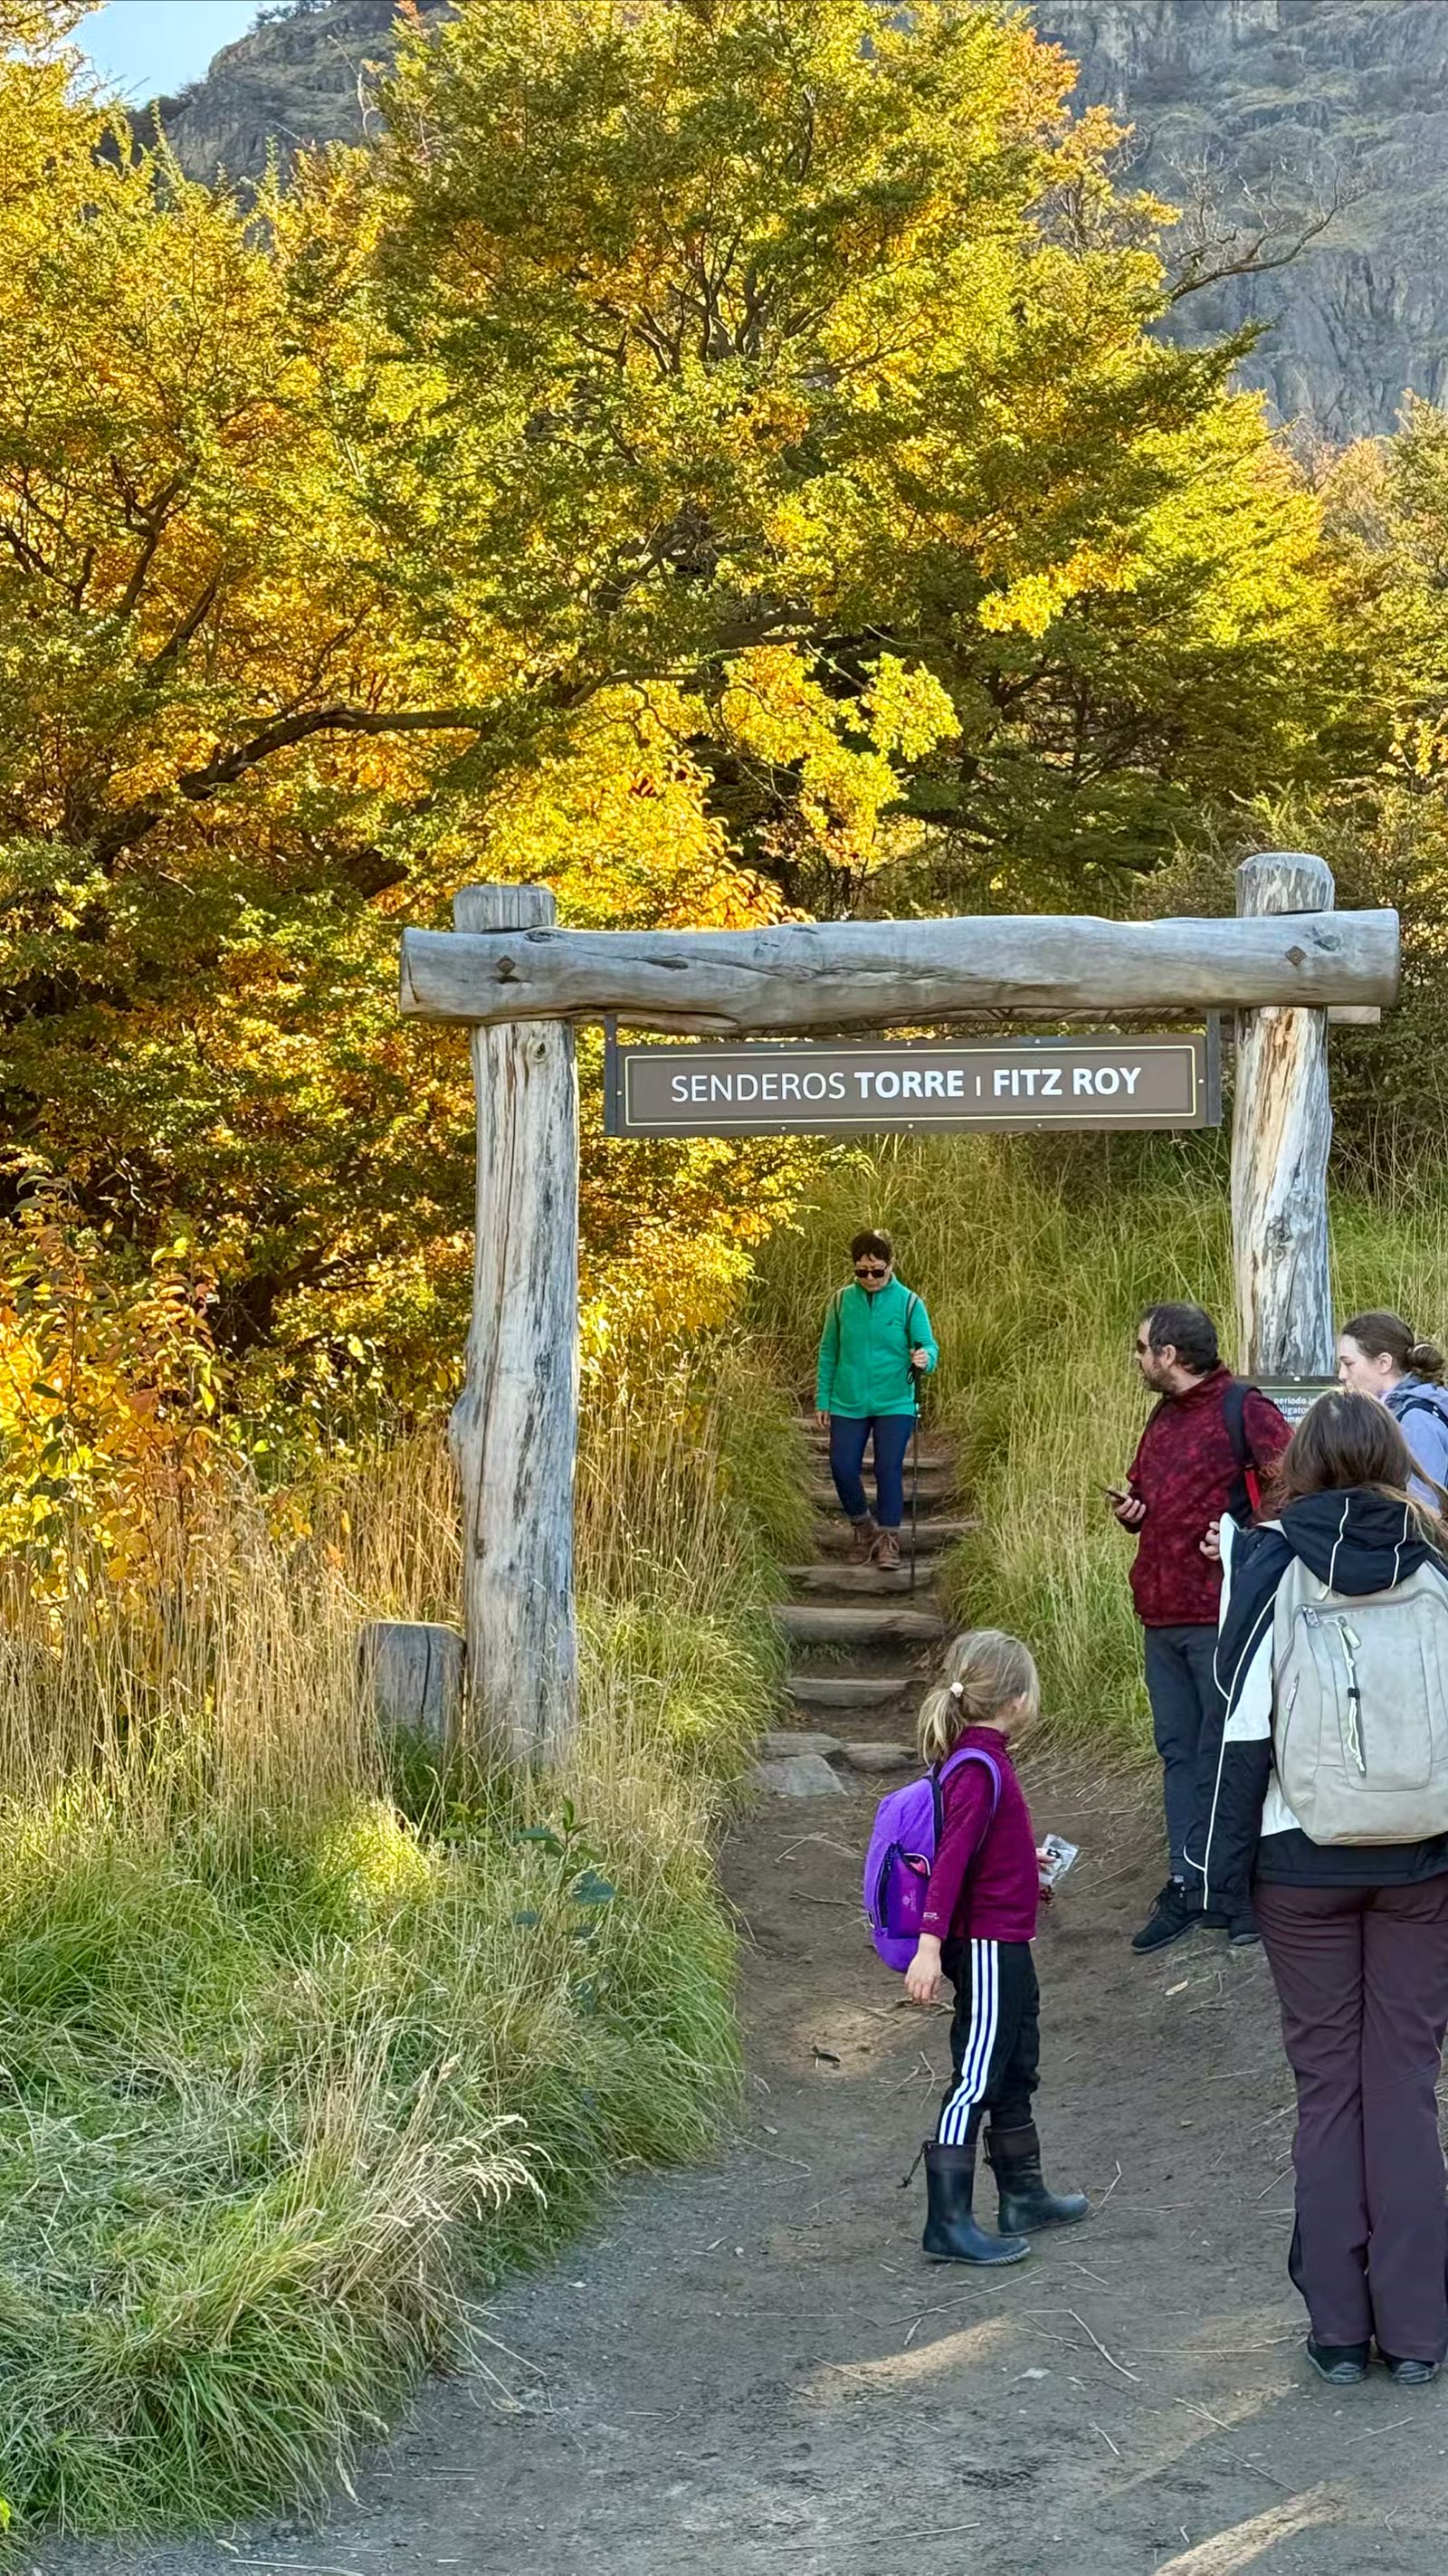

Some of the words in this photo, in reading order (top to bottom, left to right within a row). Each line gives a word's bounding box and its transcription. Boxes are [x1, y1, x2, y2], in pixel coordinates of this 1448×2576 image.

[671, 1072, 846, 1102] SENDEROS
[853, 1070, 966, 1099] TORRE
[993, 1068, 1063, 1097] FITZ
[1072, 1066, 1143, 1095] ROY
